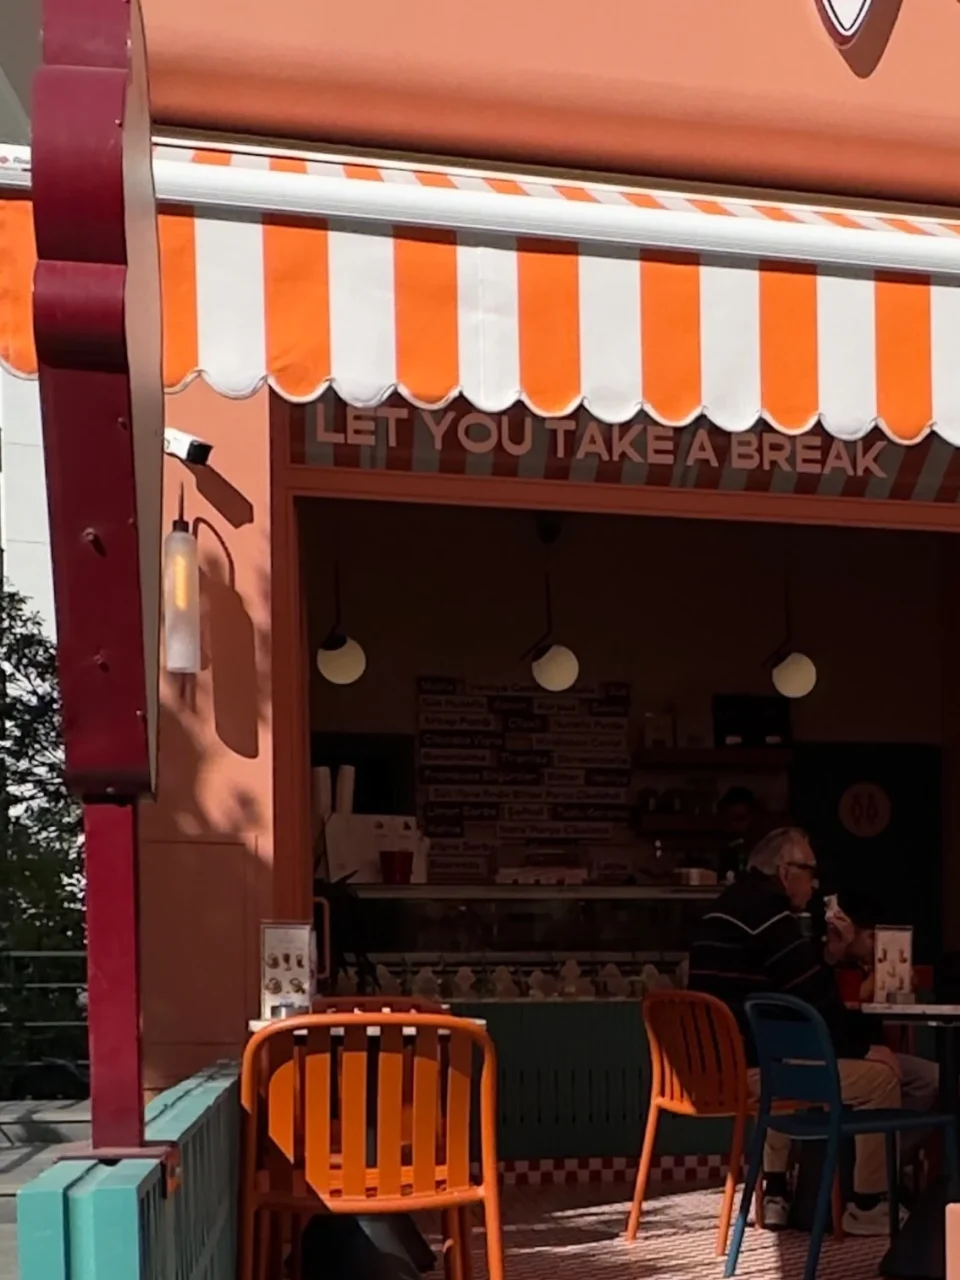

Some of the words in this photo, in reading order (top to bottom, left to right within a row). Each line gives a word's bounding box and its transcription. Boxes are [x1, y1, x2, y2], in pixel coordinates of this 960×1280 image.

[315, 402, 408, 447] LET
[421, 411, 532, 456] YOU
[544, 420, 675, 464] TAKE
[686, 428, 719, 467] A
[731, 433, 887, 478] BREAK
